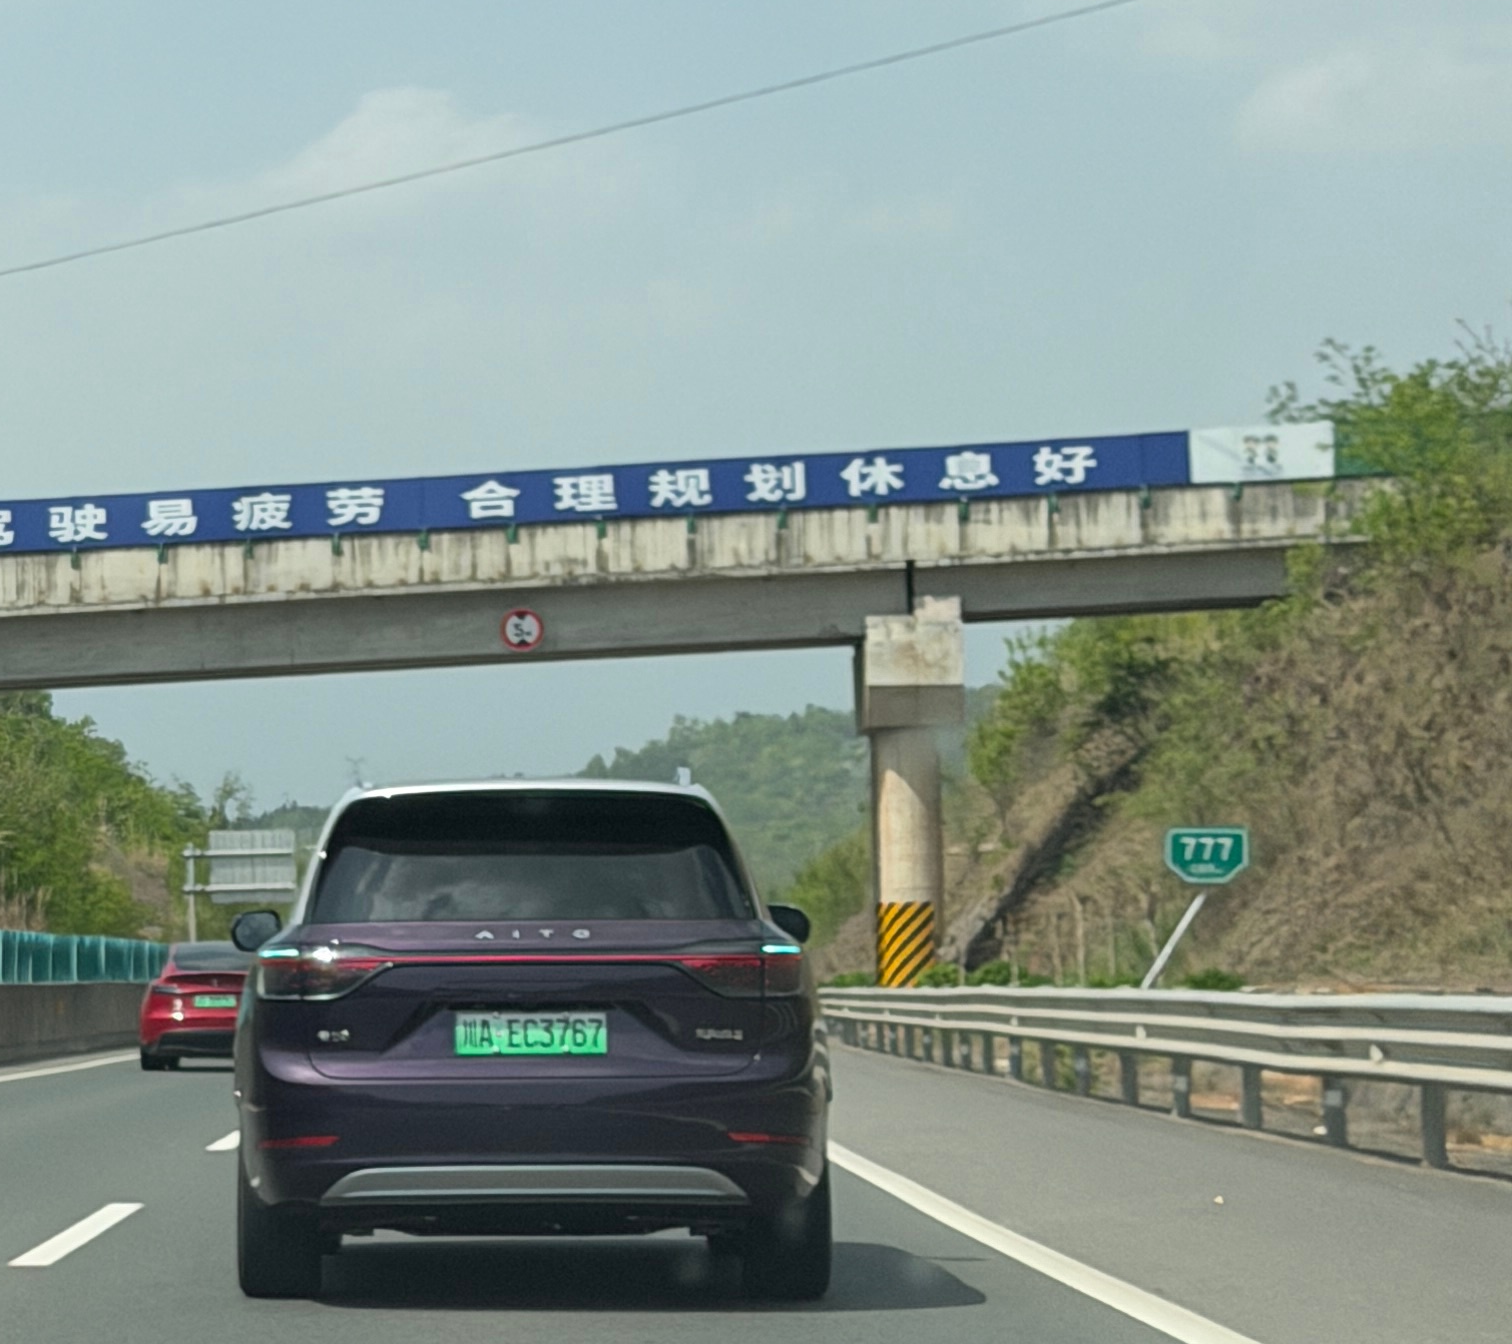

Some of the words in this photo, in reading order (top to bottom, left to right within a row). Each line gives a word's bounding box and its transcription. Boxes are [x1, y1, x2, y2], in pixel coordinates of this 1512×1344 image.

[459, 445, 1098, 520] 合理规划休息好
[1179, 836, 1234, 861] 777
[474, 928, 591, 941] AITO
